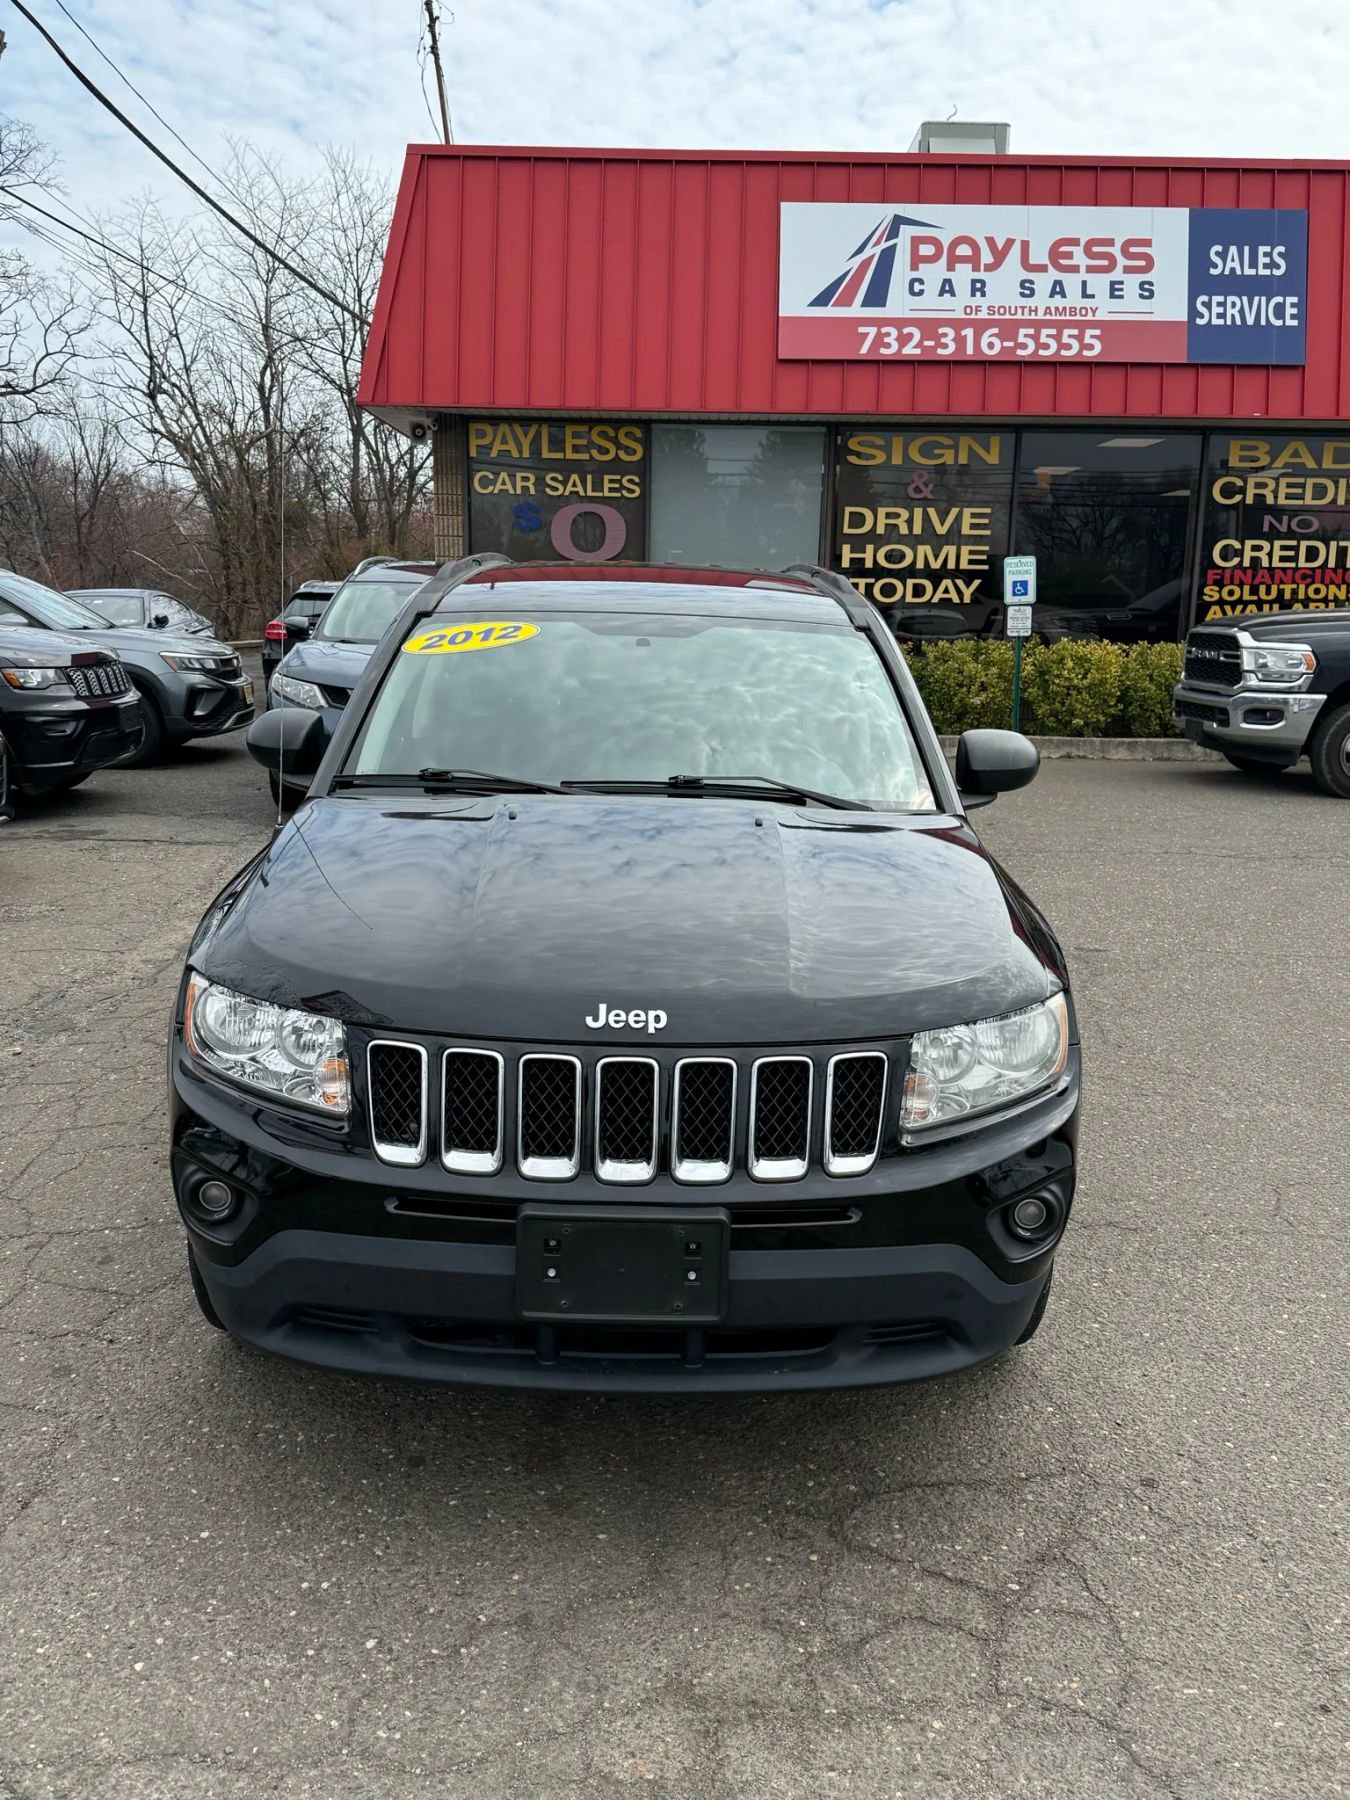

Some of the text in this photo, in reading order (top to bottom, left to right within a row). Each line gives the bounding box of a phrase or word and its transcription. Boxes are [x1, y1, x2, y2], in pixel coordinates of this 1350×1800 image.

[909, 235, 1155, 275] PAYLESS
[1208, 244, 1287, 276] SALES
[908, 277, 1155, 300] CAR SALES
[963, 304, 1099, 318] OF SOUTH AMBOY
[1195, 295, 1299, 327] SERVICE
[857, 326, 1102, 357] 732-316-5555
[468, 422, 645, 462] PAYLESS
[846, 435, 1000, 466] SIGN
[1228, 440, 1350, 470] BAD
[472, 470, 641, 498] CAR SALES
[907, 469, 935, 500] &
[1212, 476, 1350, 506] CREDI
[842, 506, 992, 536] DRIVE
[1262, 515, 1320, 533] NO
[841, 543, 990, 571] HOME
[849, 577, 982, 604] TODAY
[1206, 569, 1350, 585] FINANCIN
[1202, 584, 1350, 602] SOLUTION
[418, 625, 523, 651] 2012
[585, 1003, 668, 1034] Jeep
